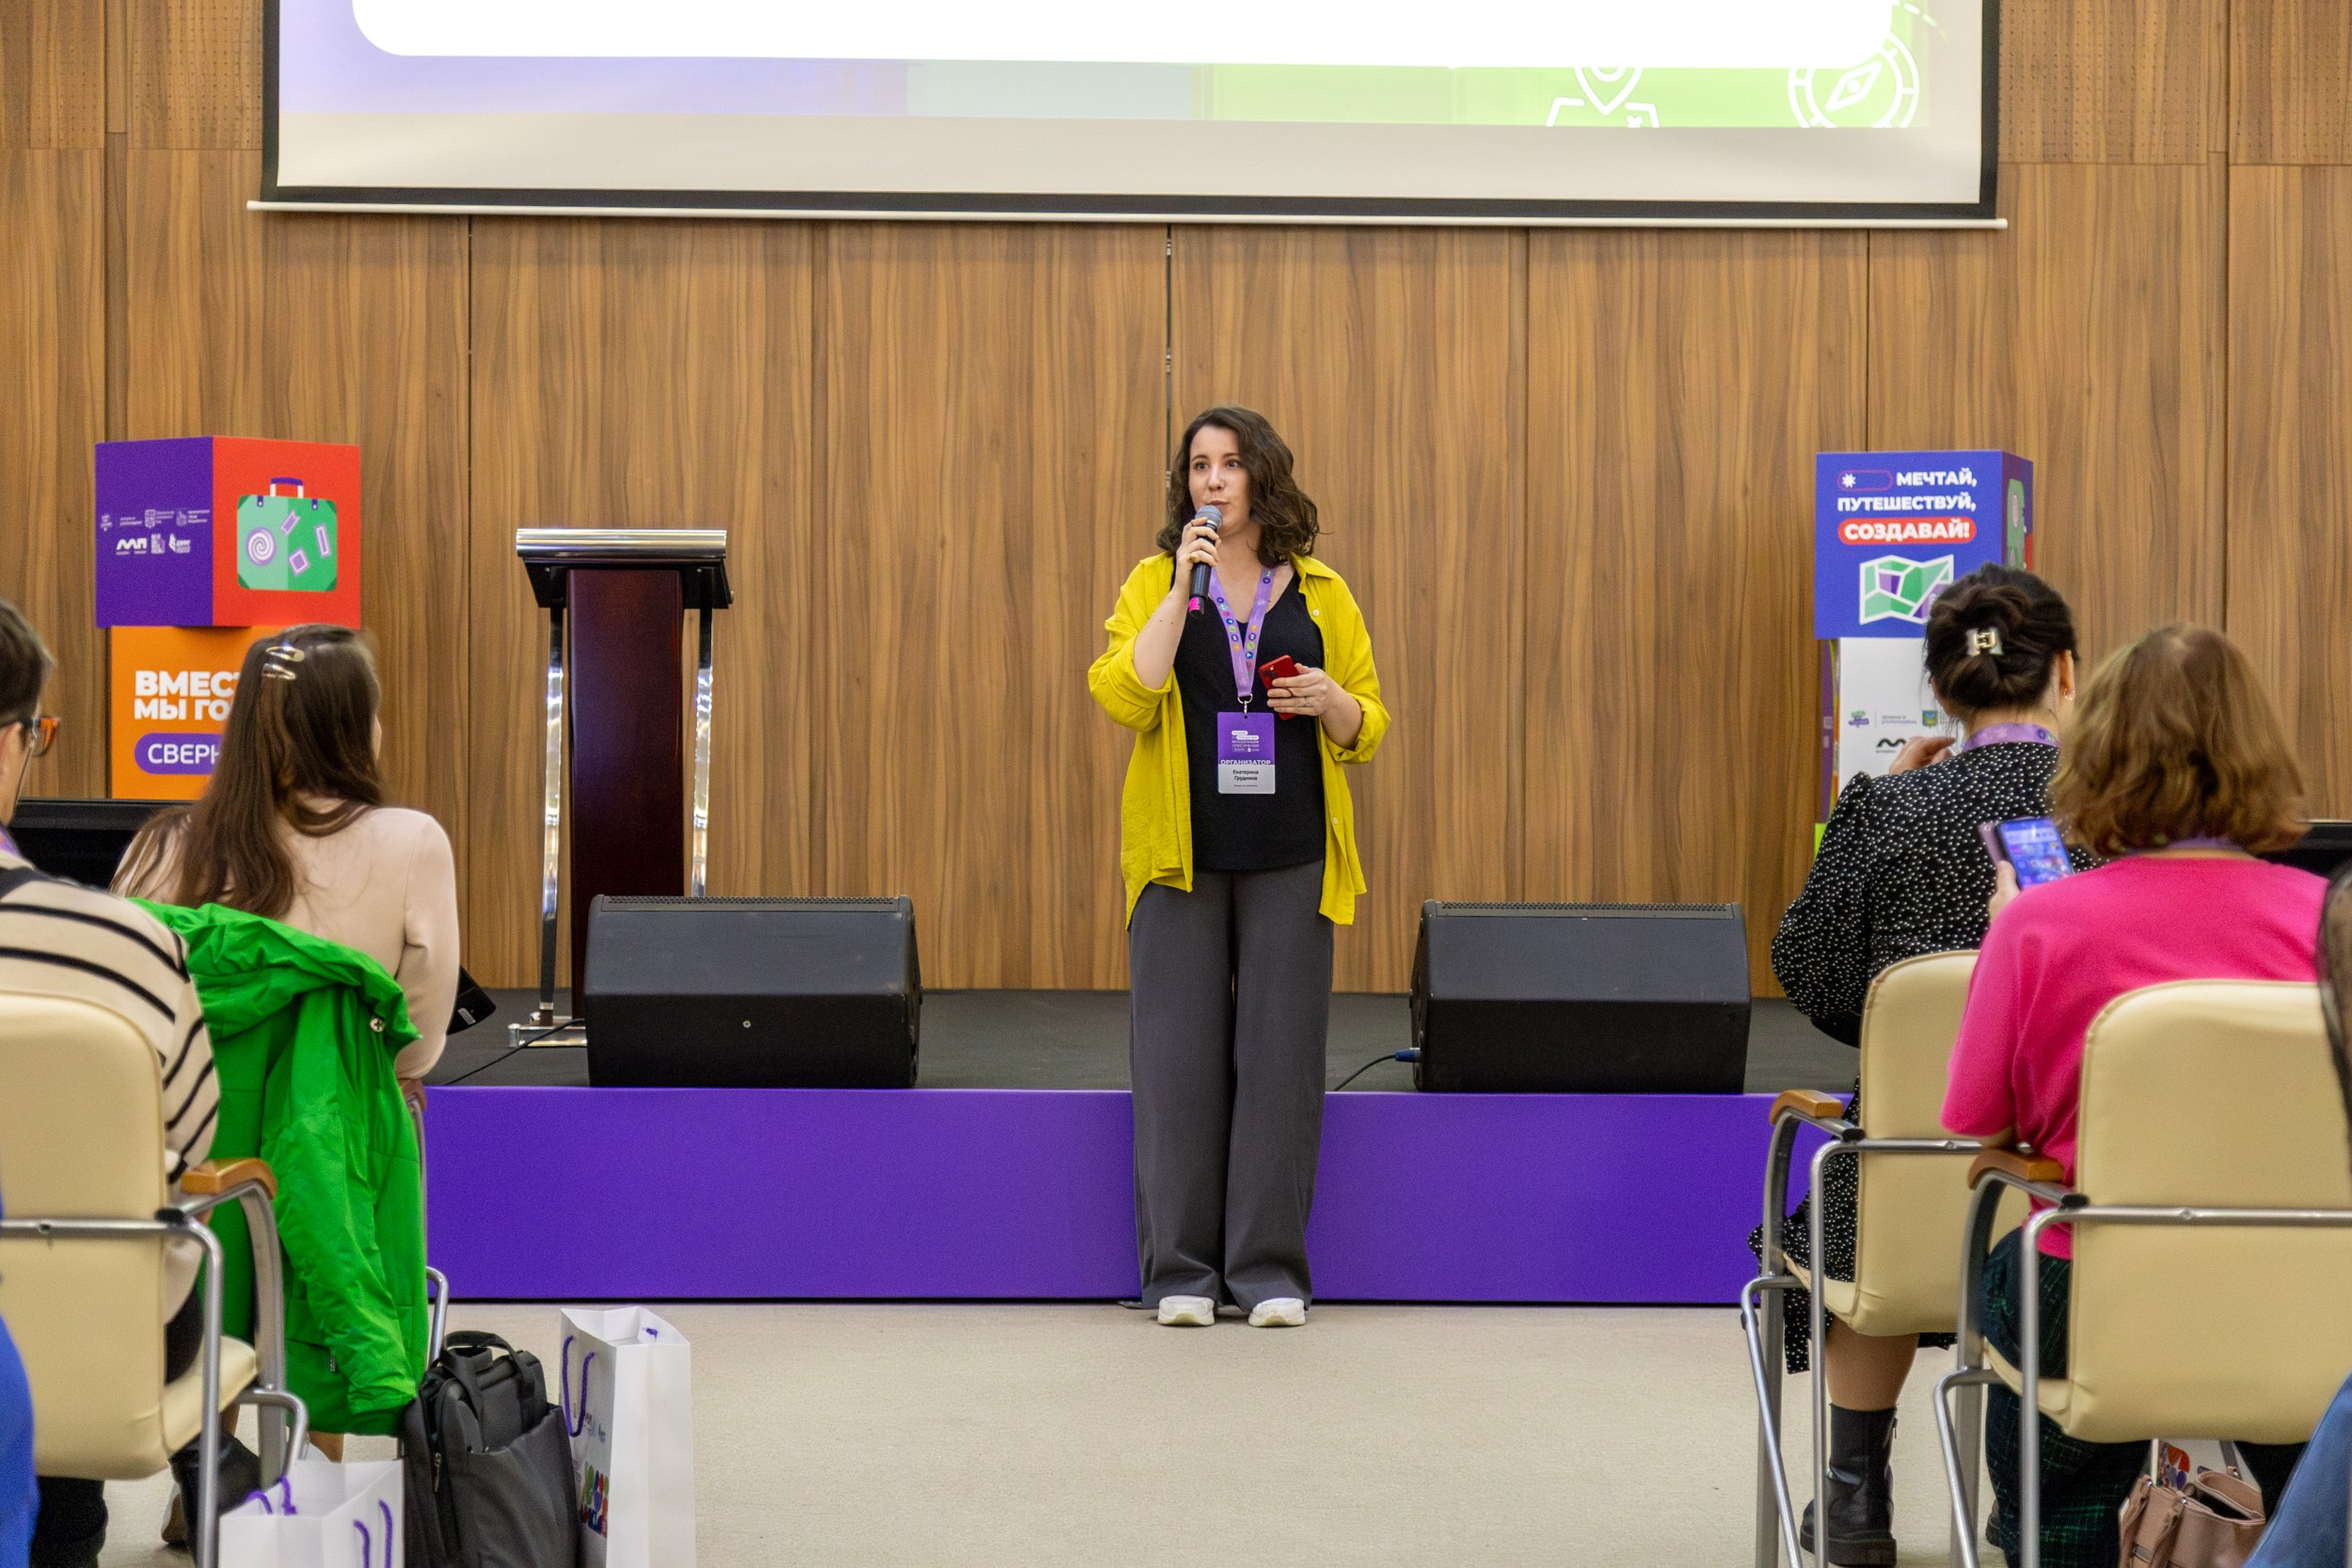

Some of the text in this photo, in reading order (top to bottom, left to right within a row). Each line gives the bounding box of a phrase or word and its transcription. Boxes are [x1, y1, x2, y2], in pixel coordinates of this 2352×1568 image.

[1896, 467, 1978, 487] МЕЧТАЙ,
[1837, 492, 1977, 512] ПУТЕШЕСТВУЙ,
[1844, 518, 1970, 542] СОЗДАВАЙ!
[134, 698, 187, 721] МЫ
